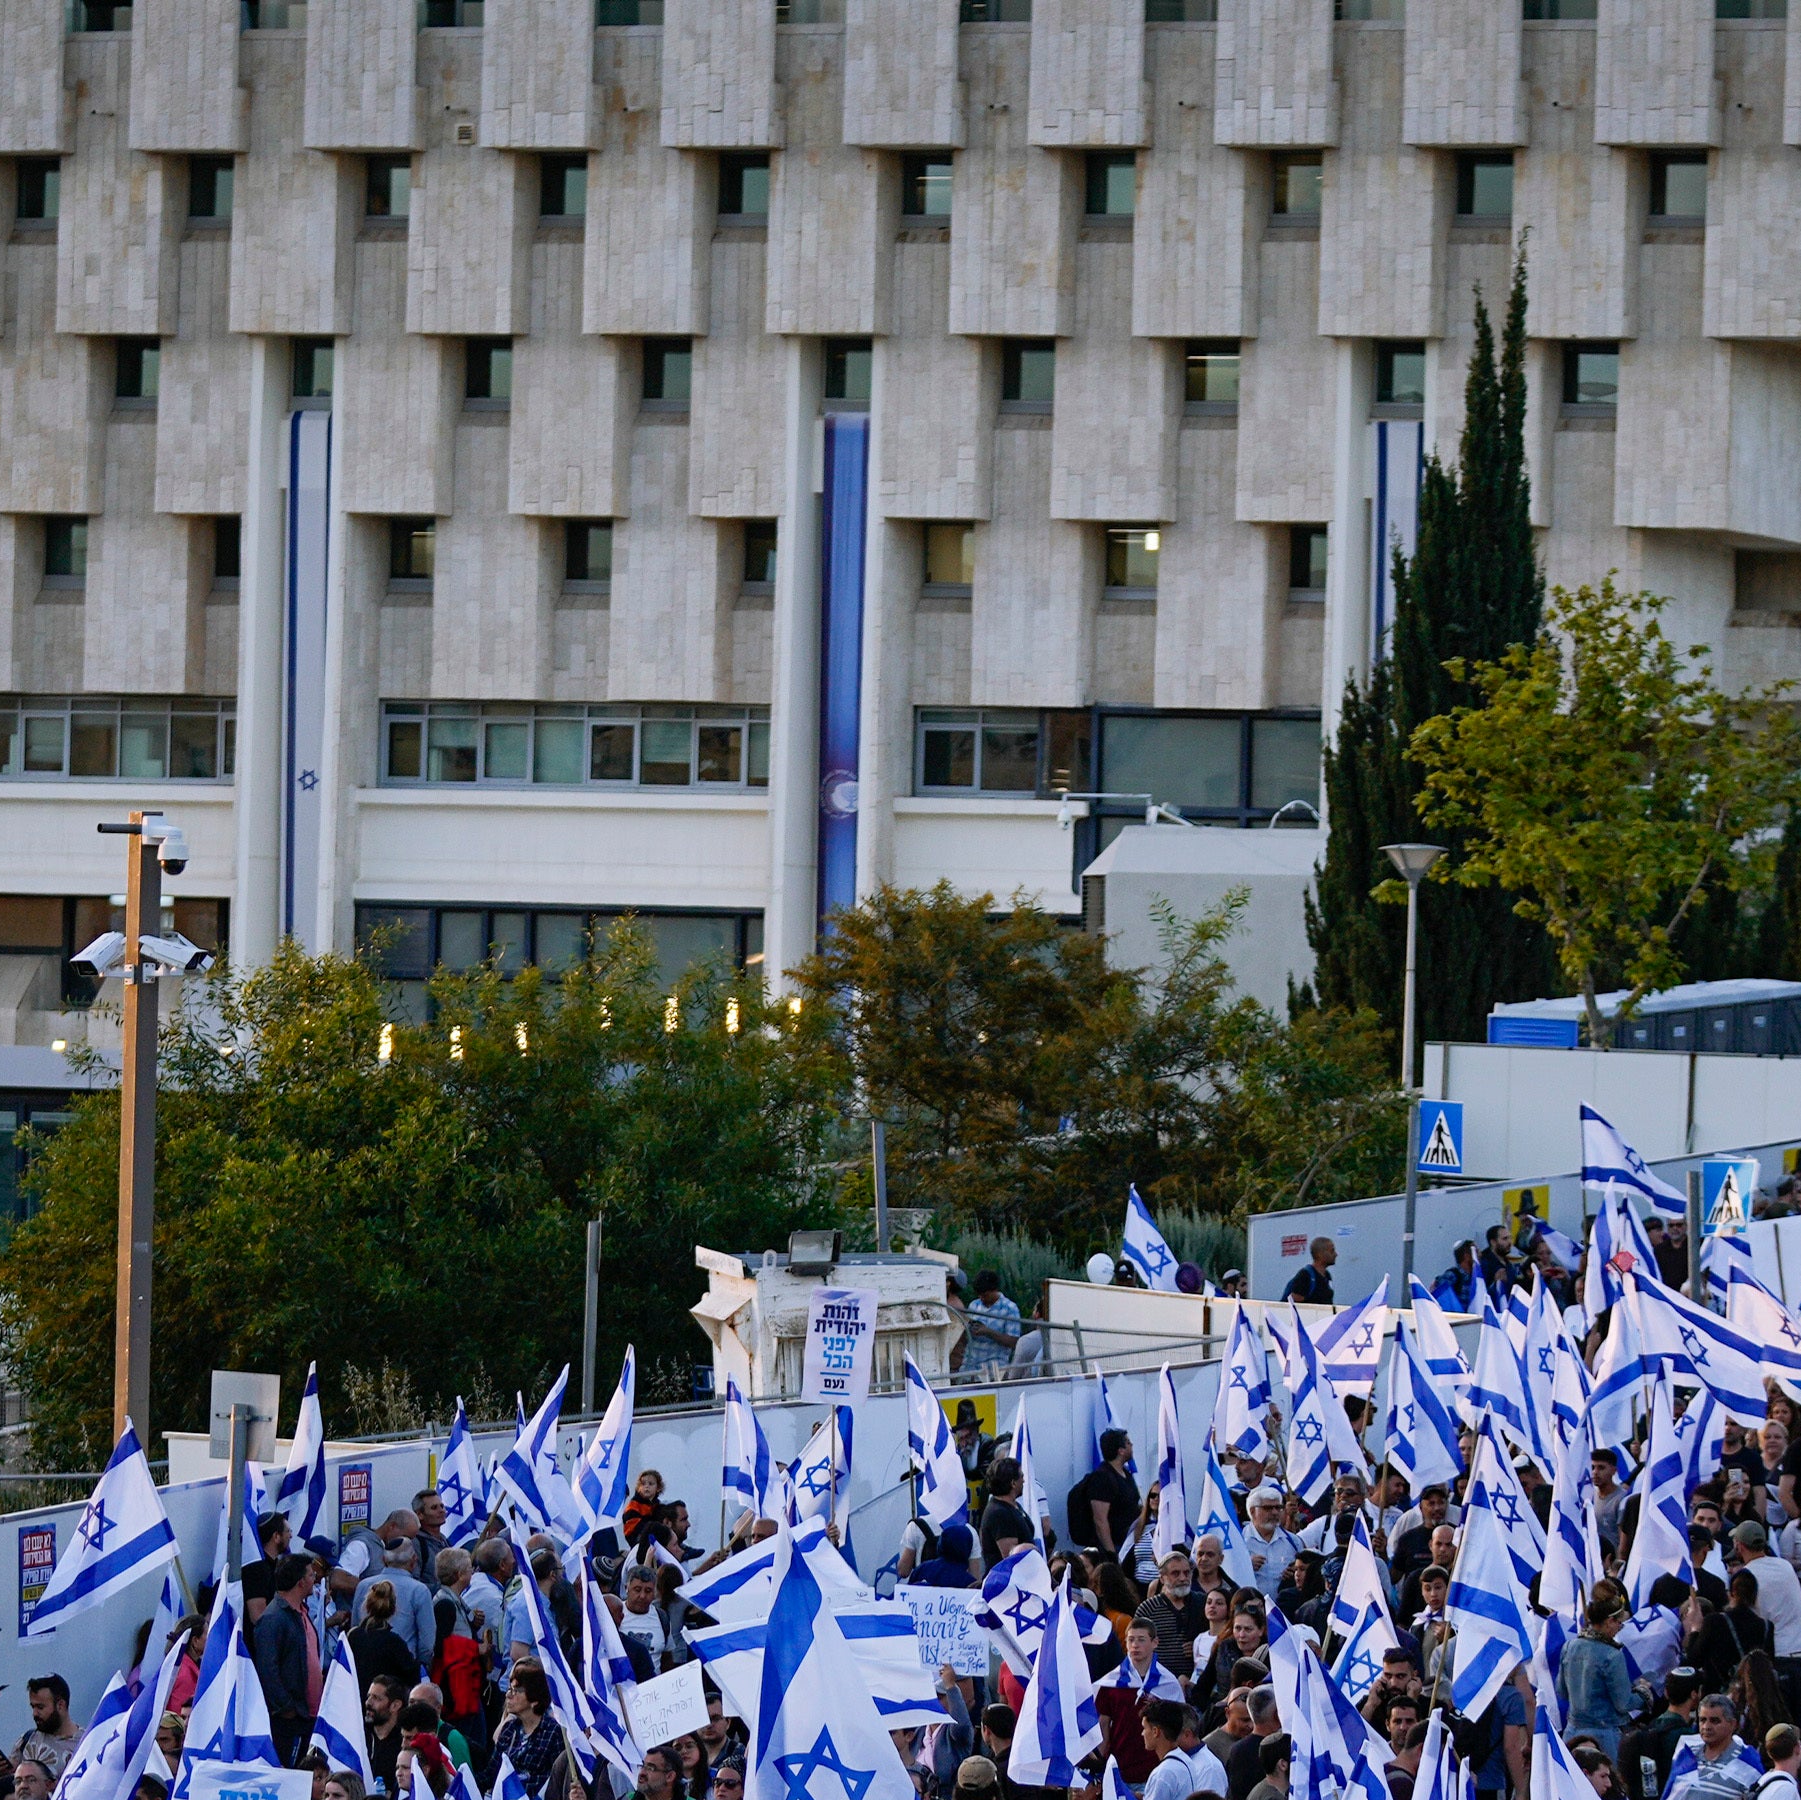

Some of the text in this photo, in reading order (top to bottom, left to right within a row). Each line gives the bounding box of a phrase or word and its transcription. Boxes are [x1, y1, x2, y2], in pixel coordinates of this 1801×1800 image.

[822, 1303, 860, 1320] זהות
[814, 1318, 867, 1336] יהודית
[822, 1334, 856, 1352] לפני
[822, 1350, 853, 1369] הכל
